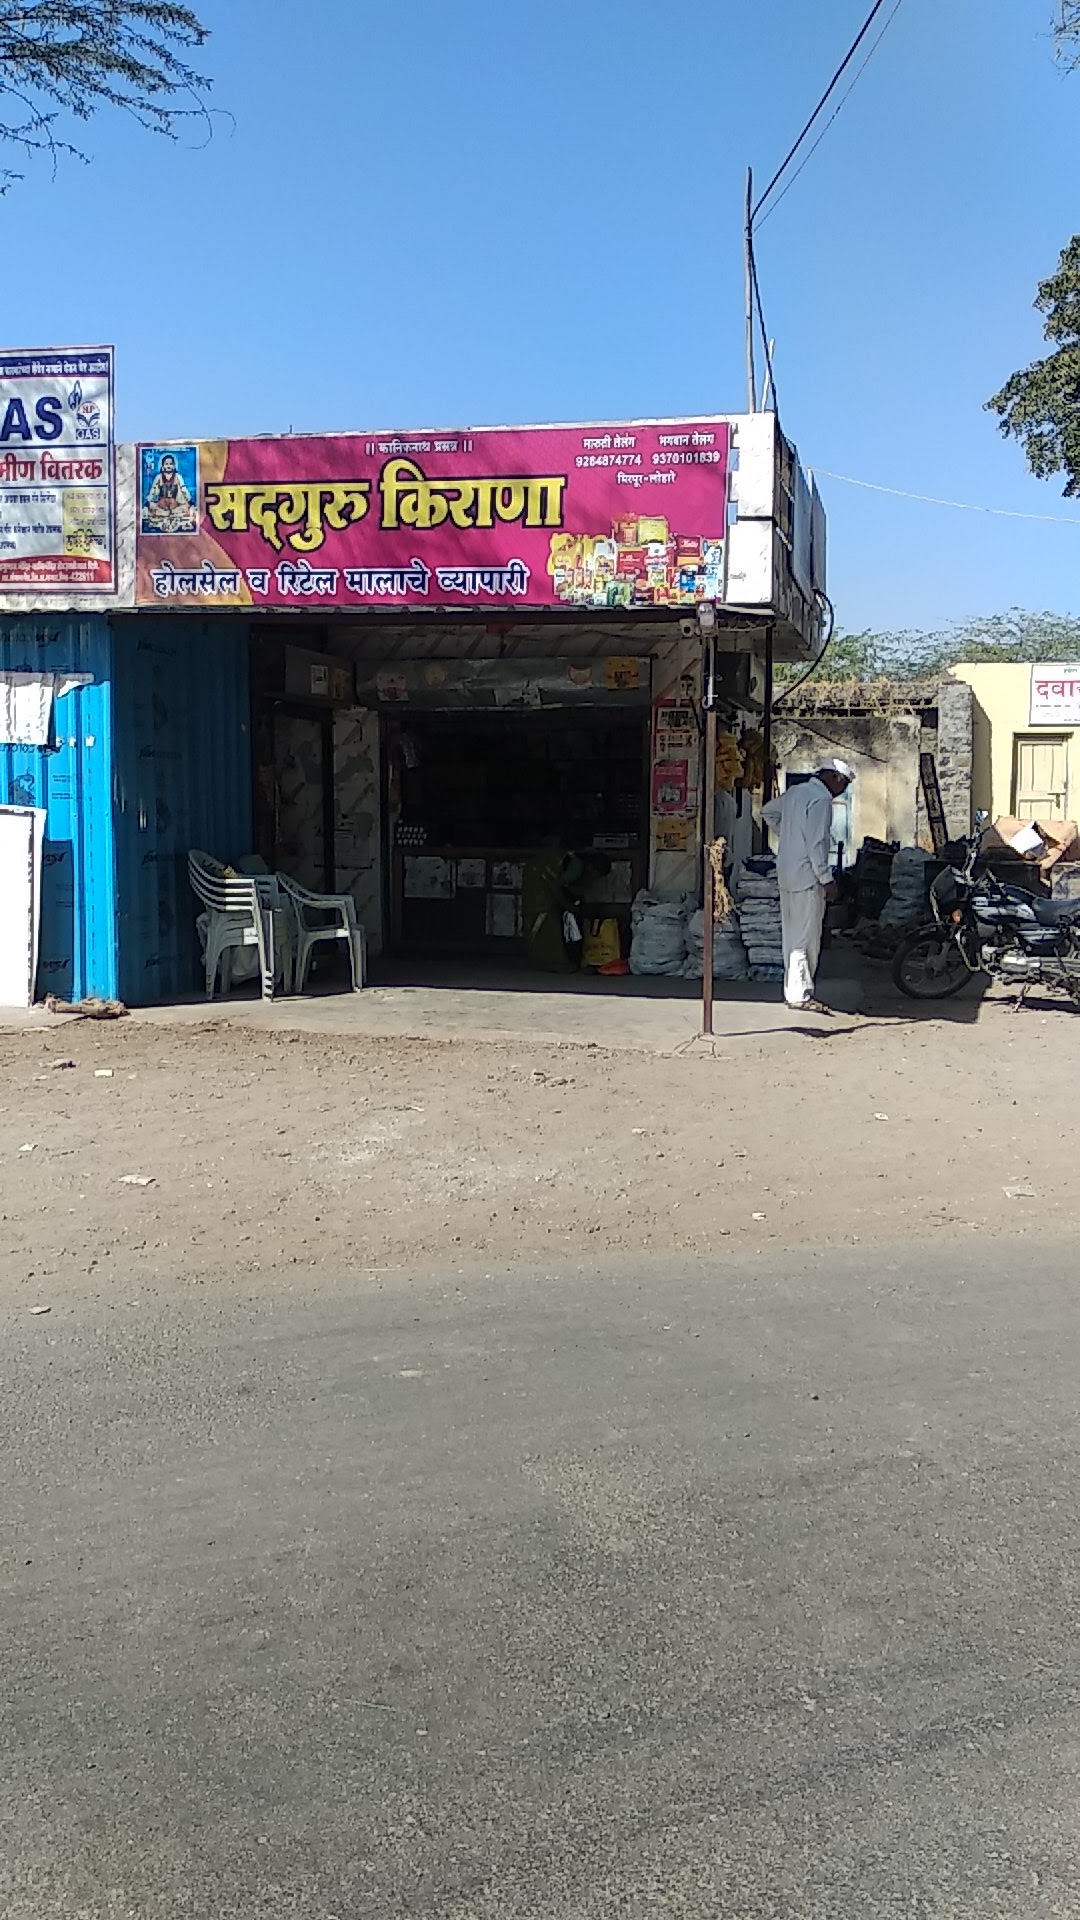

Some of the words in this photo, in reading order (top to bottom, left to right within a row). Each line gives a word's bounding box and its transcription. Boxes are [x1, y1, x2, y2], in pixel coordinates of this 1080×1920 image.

[77, 428, 100, 439] GAS
[40, 451, 103, 480] वितरक
[207, 482, 371, 552] सद्गुरु
[379, 458, 566, 528] किराणा
[151, 559, 241, 596] होलसेल
[247, 568, 271, 595] व
[276, 559, 339, 596] रिटेल
[344, 558, 431, 595] मालाचे
[436, 559, 530, 595] व्यापारी
[1035, 680, 1080, 700] दवा
